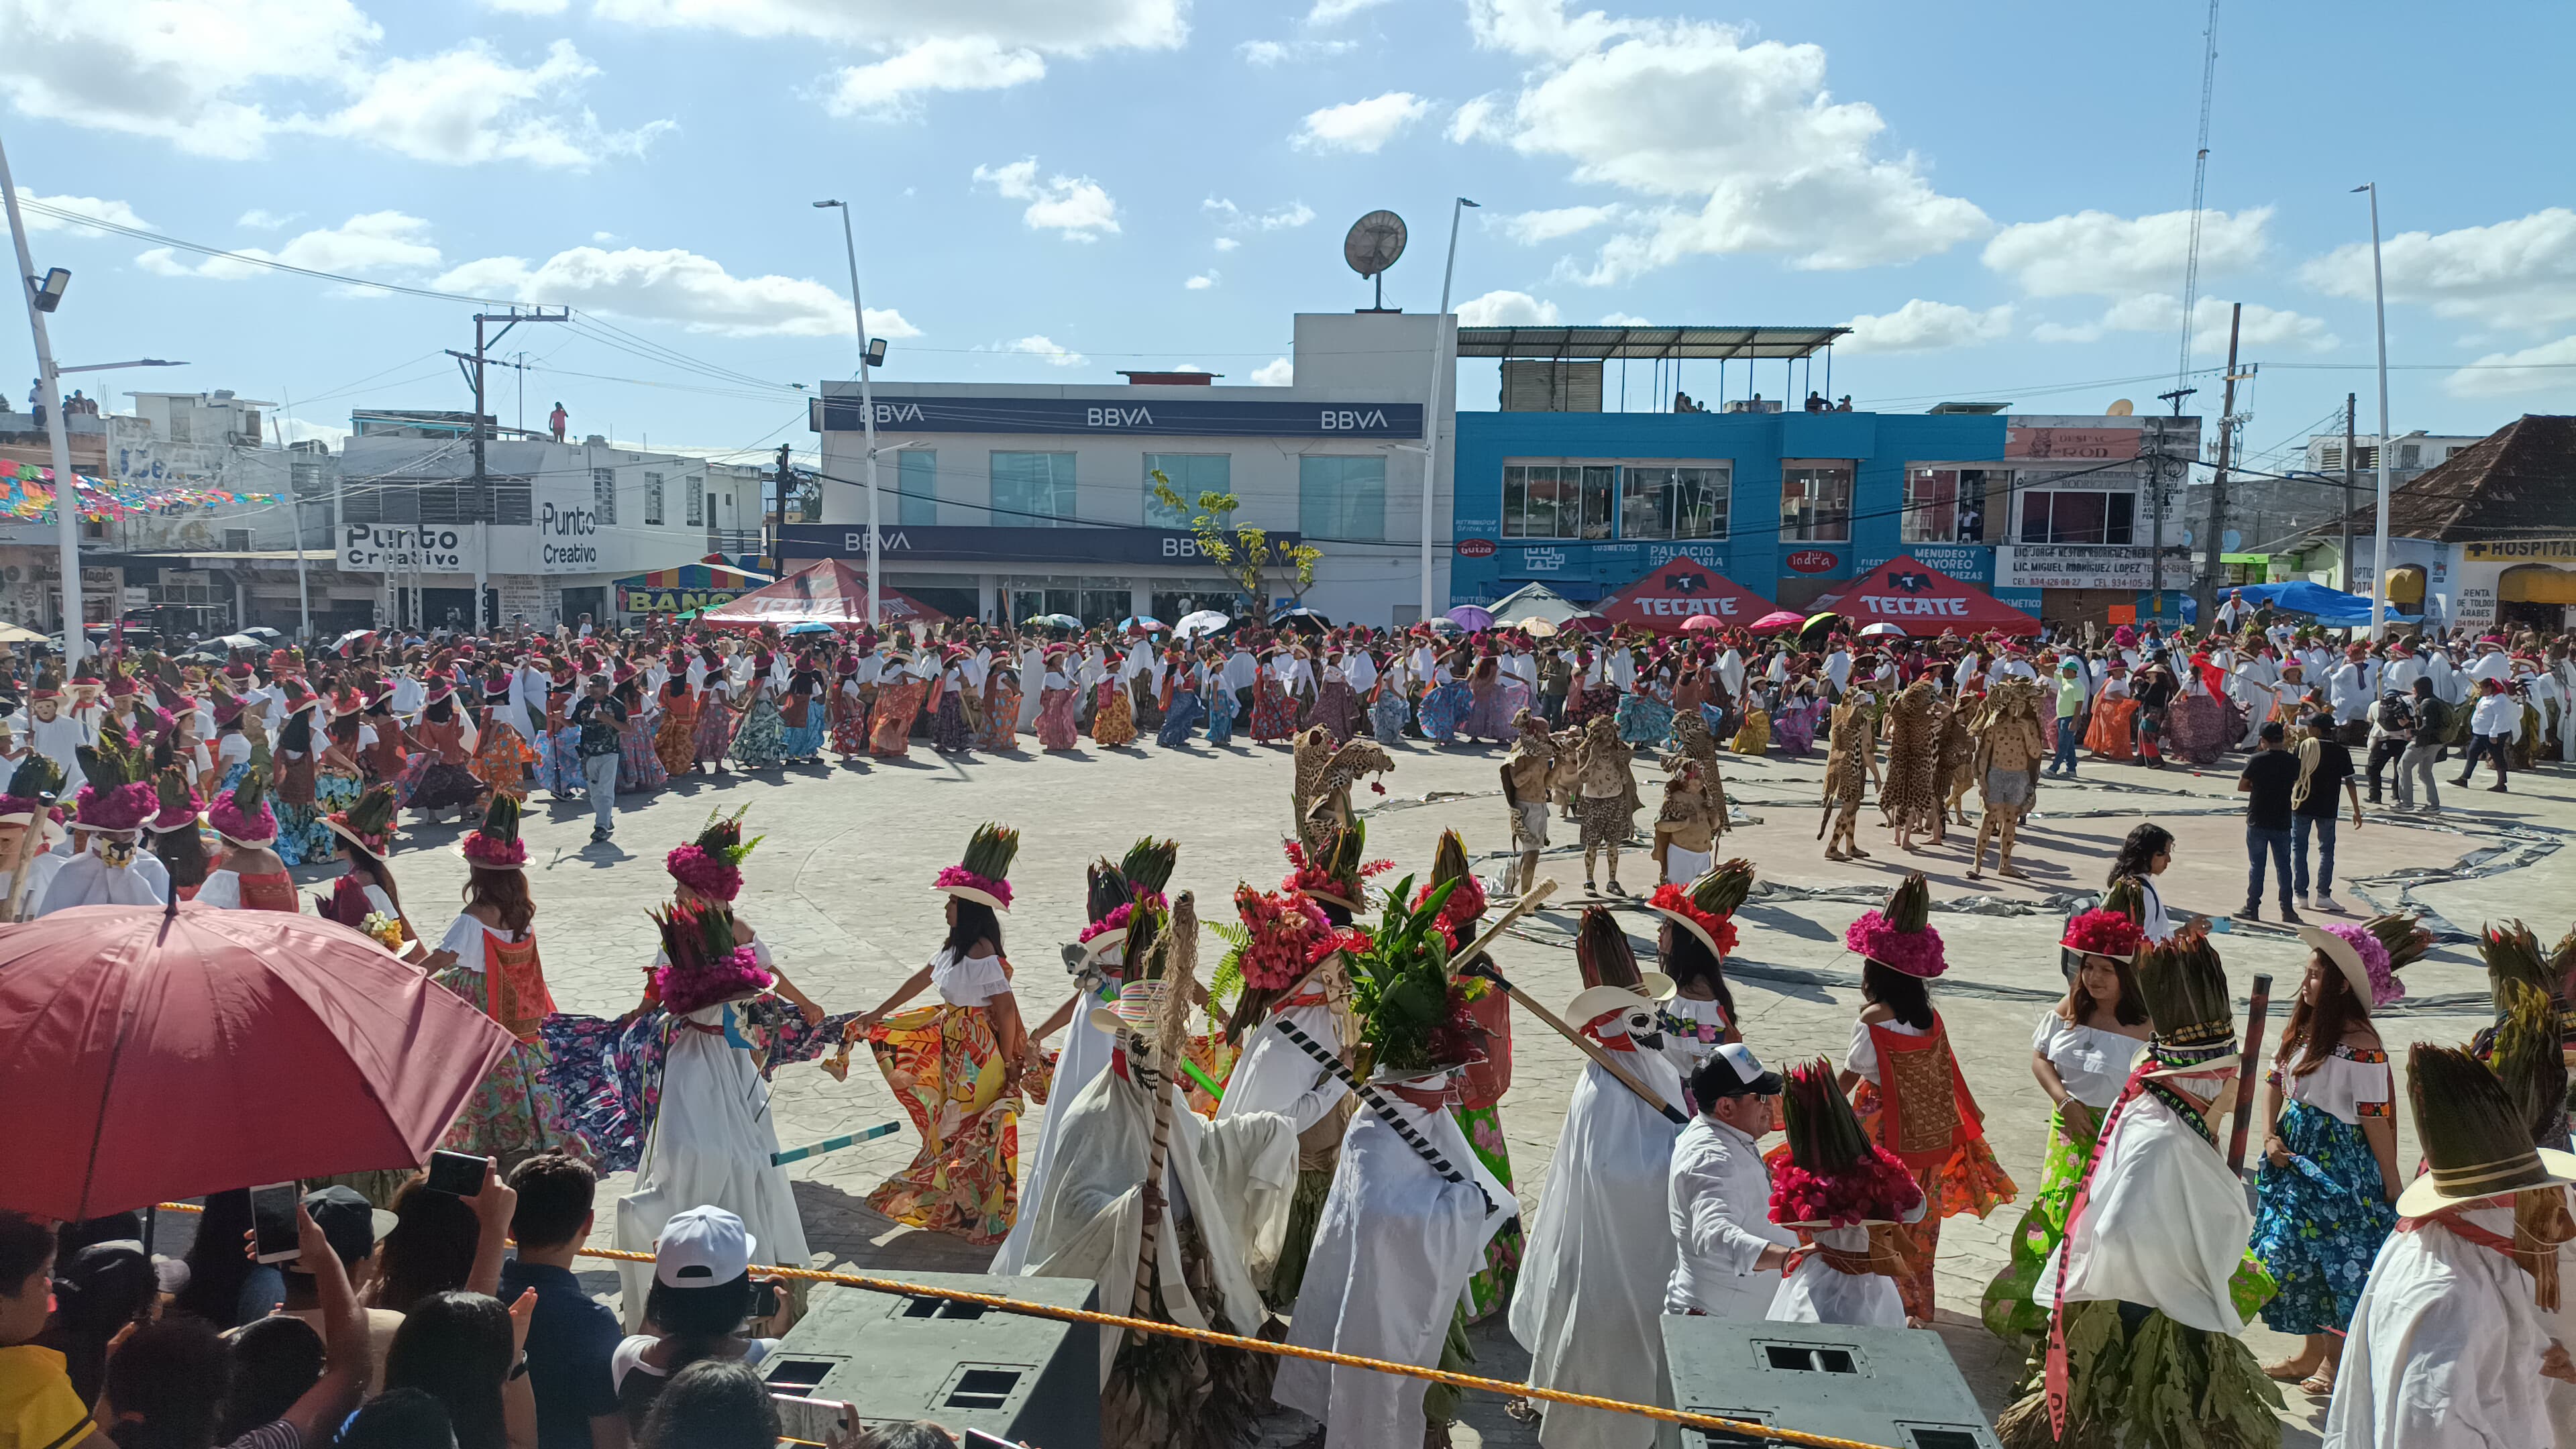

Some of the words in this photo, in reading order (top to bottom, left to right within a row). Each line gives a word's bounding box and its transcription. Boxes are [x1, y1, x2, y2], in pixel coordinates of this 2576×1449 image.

[1087, 406, 1154, 427] BBVA
[1321, 409, 1388, 429] BBVA
[543, 502, 596, 535] Punto
[347, 524, 458, 549] Punto
[543, 543, 596, 564] Creativo
[1650, 545, 1714, 557] PALACIO
[1915, 549, 1967, 558] MENUDEO
[2491, 541, 2576, 556] HOSPITA
[1949, 571, 1983, 580] PIEZAS
[2031, 563, 2063, 572] MIGUEL
[2114, 564, 2141, 573] LOPEZ
[2463, 589, 2490, 597] RENTA
[1633, 597, 1739, 616] TECATE
[1859, 596, 1970, 615] TECATE
[1996, 598, 2042, 608] OSMETICO
[2457, 599, 2465, 607] DE
[2470, 599, 2495, 607] TOLDOS
